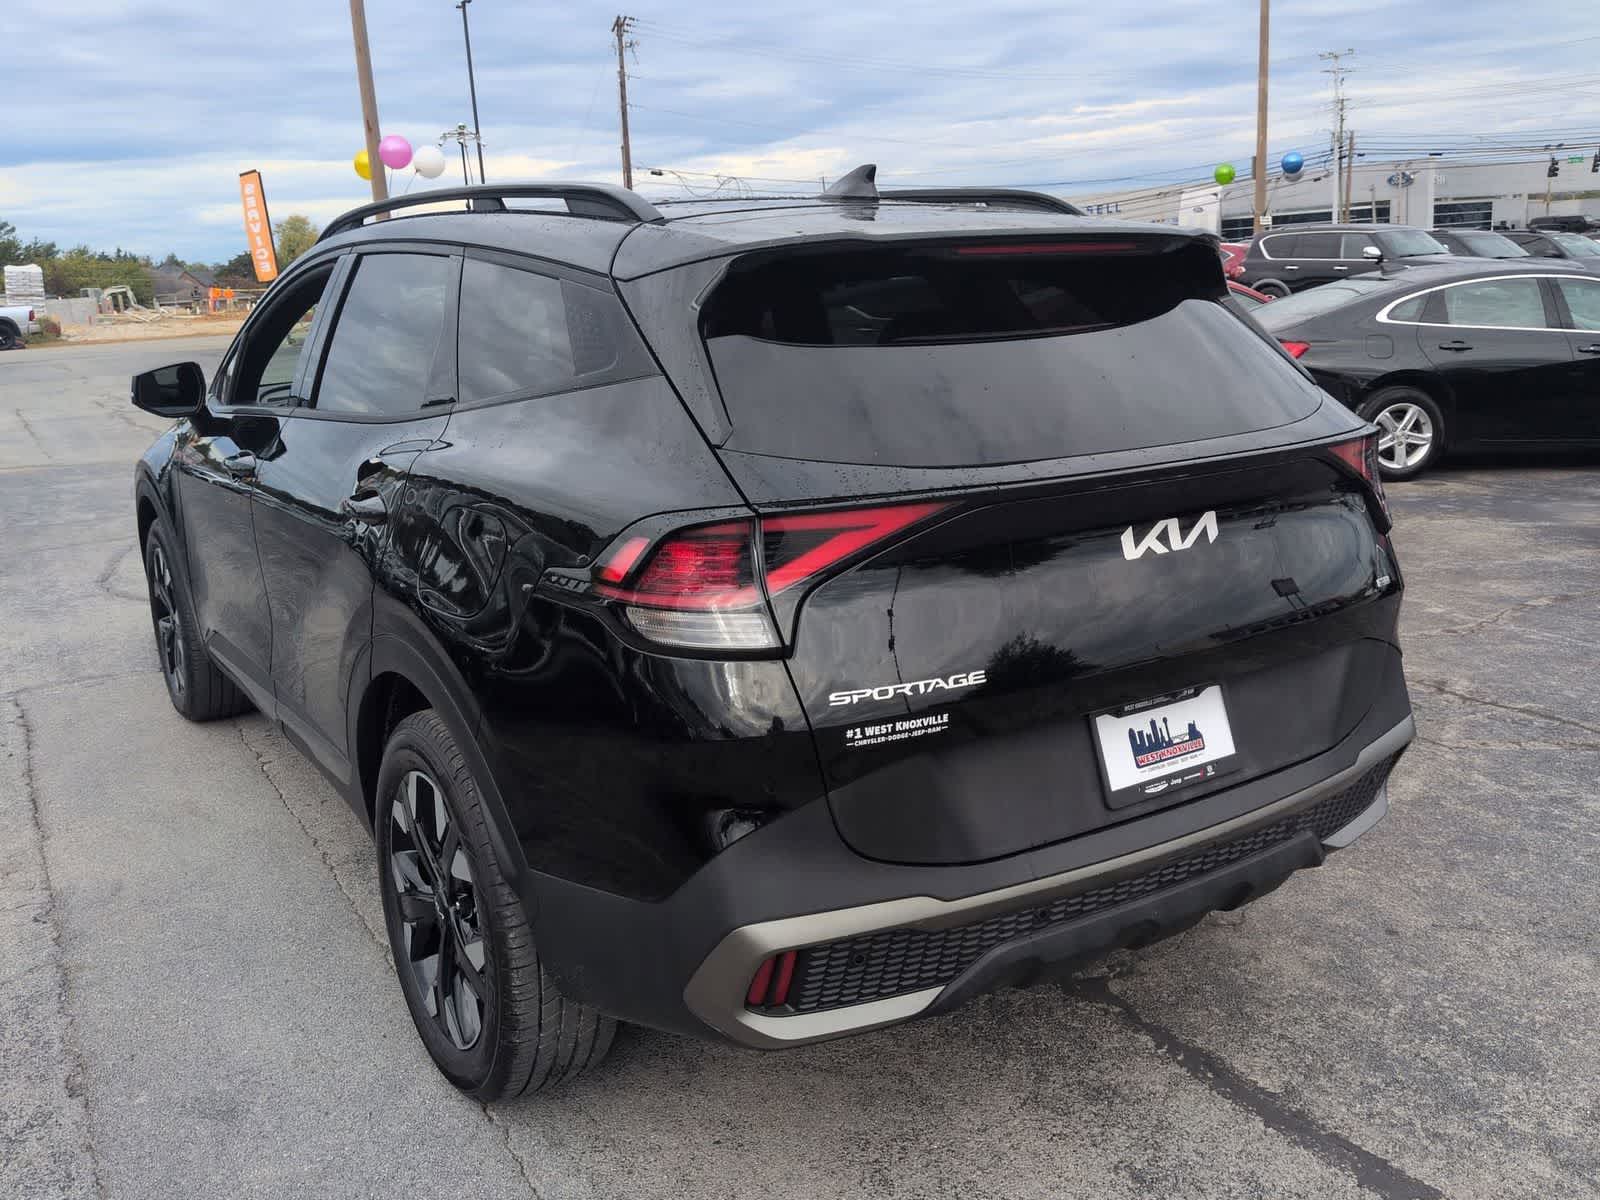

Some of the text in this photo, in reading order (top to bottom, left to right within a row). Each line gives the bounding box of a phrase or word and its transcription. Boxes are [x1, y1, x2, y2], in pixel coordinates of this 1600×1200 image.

[1120, 510, 1219, 560] KIA
[828, 670, 987, 706] SPORTAGE
[846, 713, 950, 740] #1 WEST KNOXVILLE
[1137, 752, 1160, 765] WEST
[1160, 739, 1202, 759] KNOXVILLE
